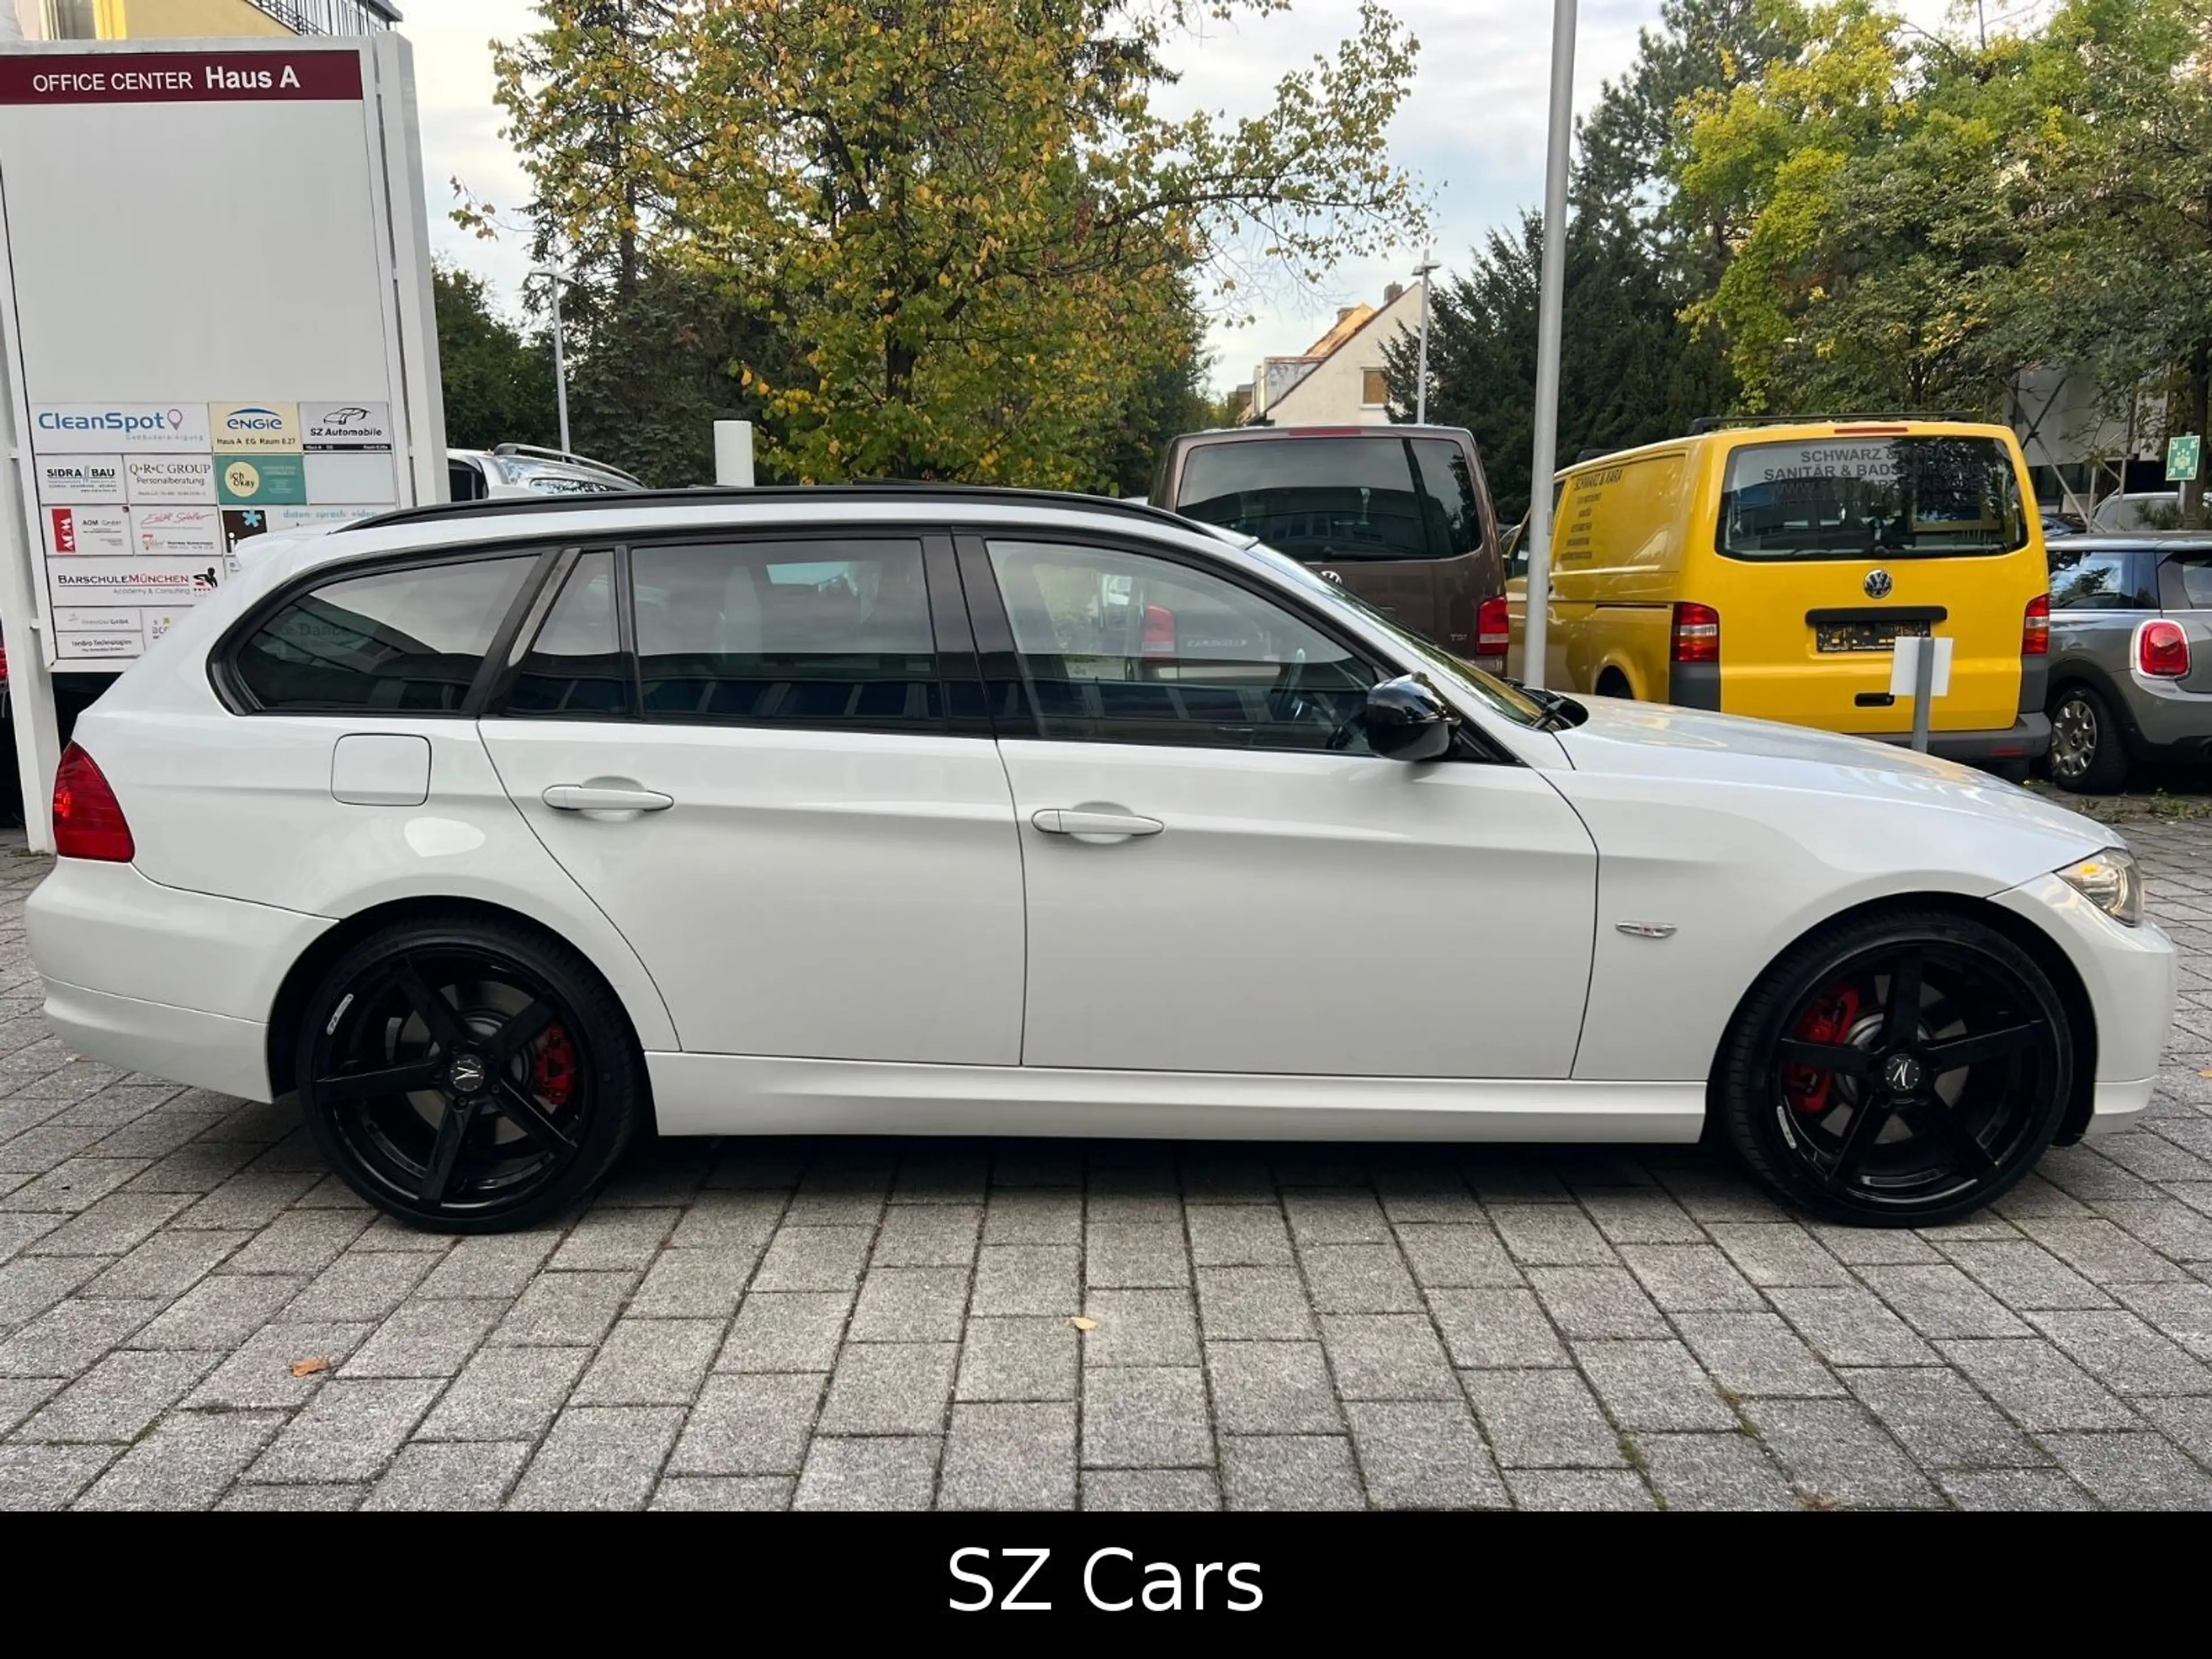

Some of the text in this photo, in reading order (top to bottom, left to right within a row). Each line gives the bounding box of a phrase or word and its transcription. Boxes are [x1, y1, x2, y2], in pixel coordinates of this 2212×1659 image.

[33, 65, 300, 92] OFFICE CENTER Haus A
[38, 411, 165, 433] CleanSpot
[310, 428, 382, 437] SZ Automobile
[1801, 448, 1881, 463] SCHWARZ
[47, 468, 115, 477] SIDRA BAU
[167, 464, 211, 474] GROUP
[1764, 464, 1835, 481] SANITÄR
[1840, 464, 1851, 478] &
[137, 477, 205, 486] Personalberatung
[58, 574, 189, 584] BARSCHULEMÜNCHEN
[113, 588, 147, 596] Academy
[154, 588, 191, 596] Consulting
